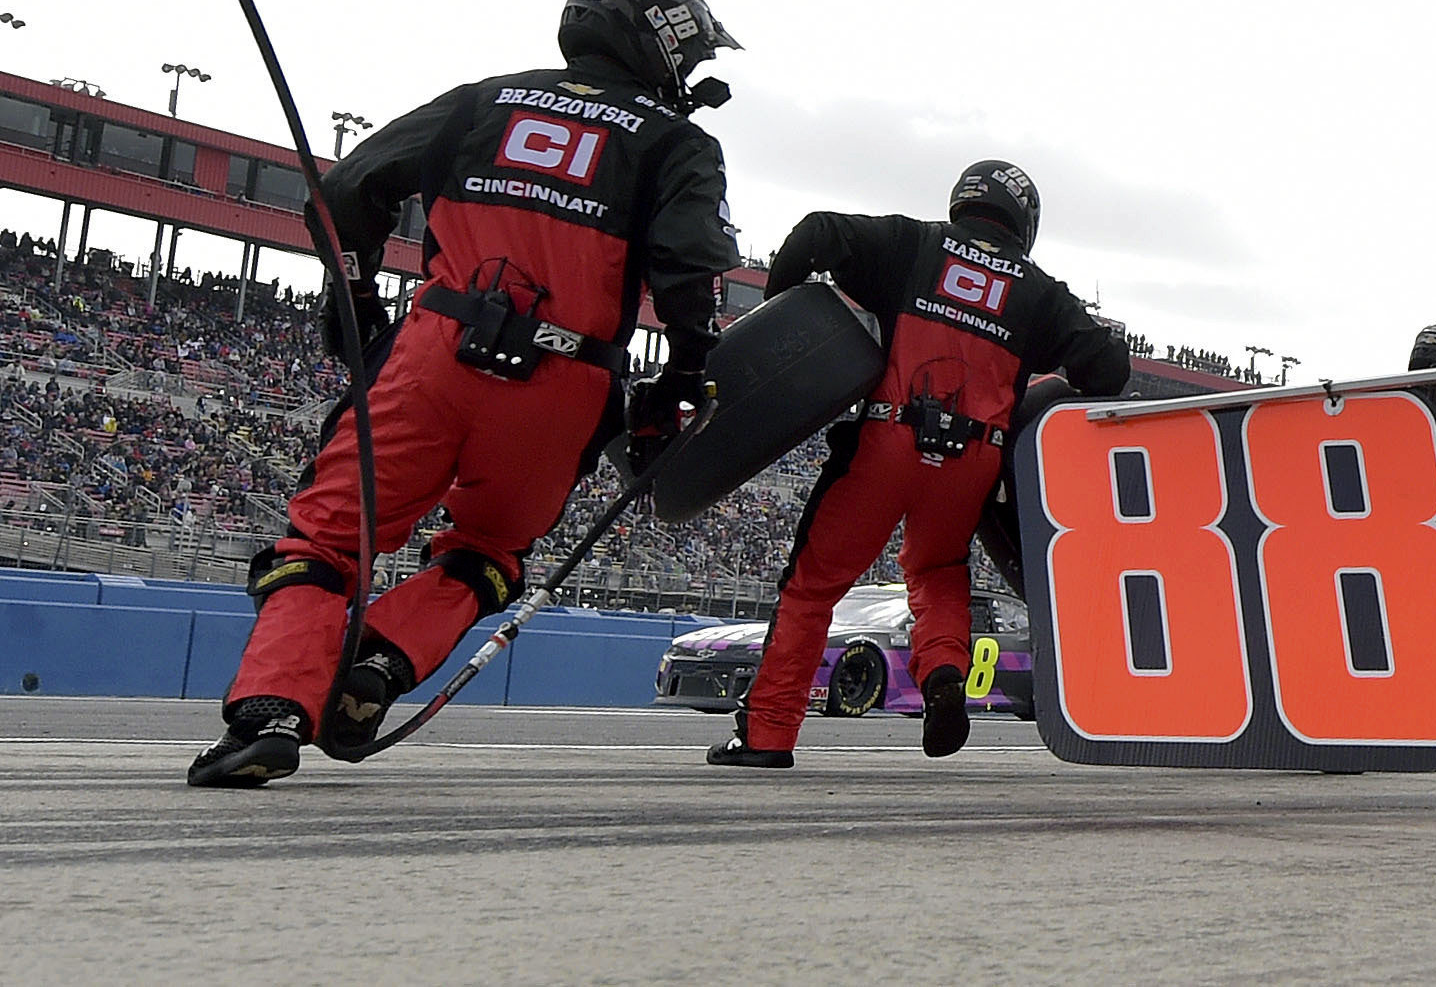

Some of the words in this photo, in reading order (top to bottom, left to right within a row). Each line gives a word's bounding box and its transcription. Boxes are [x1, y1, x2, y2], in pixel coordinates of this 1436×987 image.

[495, 87, 645, 134] BRZOZOWSKI
[504, 118, 600, 179] CI
[465, 176, 607, 217] CINCINNATI
[942, 236, 1025, 279] HARRELL
[943, 264, 1007, 311] CI
[915, 298, 1012, 341] CINCINNATI
[811, 688, 828, 698] 3M
